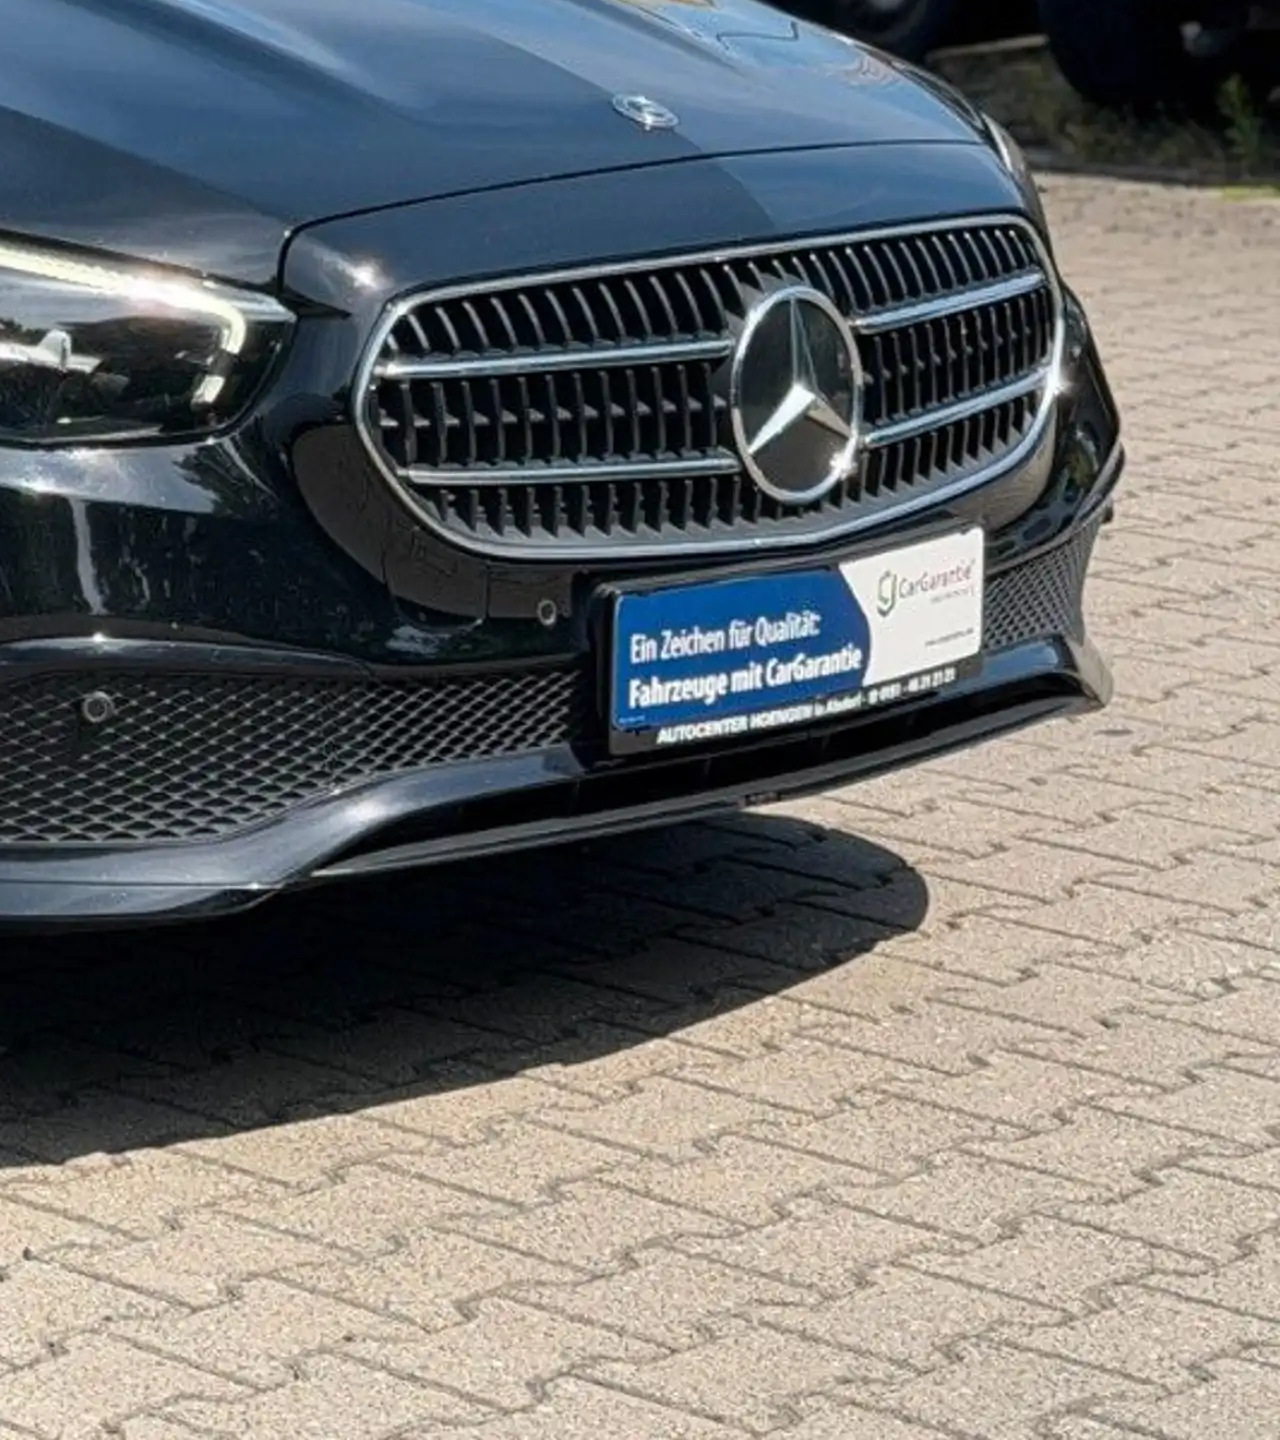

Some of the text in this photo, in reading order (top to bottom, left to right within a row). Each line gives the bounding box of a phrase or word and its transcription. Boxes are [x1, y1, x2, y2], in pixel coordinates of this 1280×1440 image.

[630, 609, 821, 665] Ein Zeichen für Qualität:
[629, 671, 729, 709] Fahrzeuge
[730, 660, 763, 693] mit
[765, 641, 862, 687] CarGarantie
[655, 715, 748, 745] AUTOCENTER
